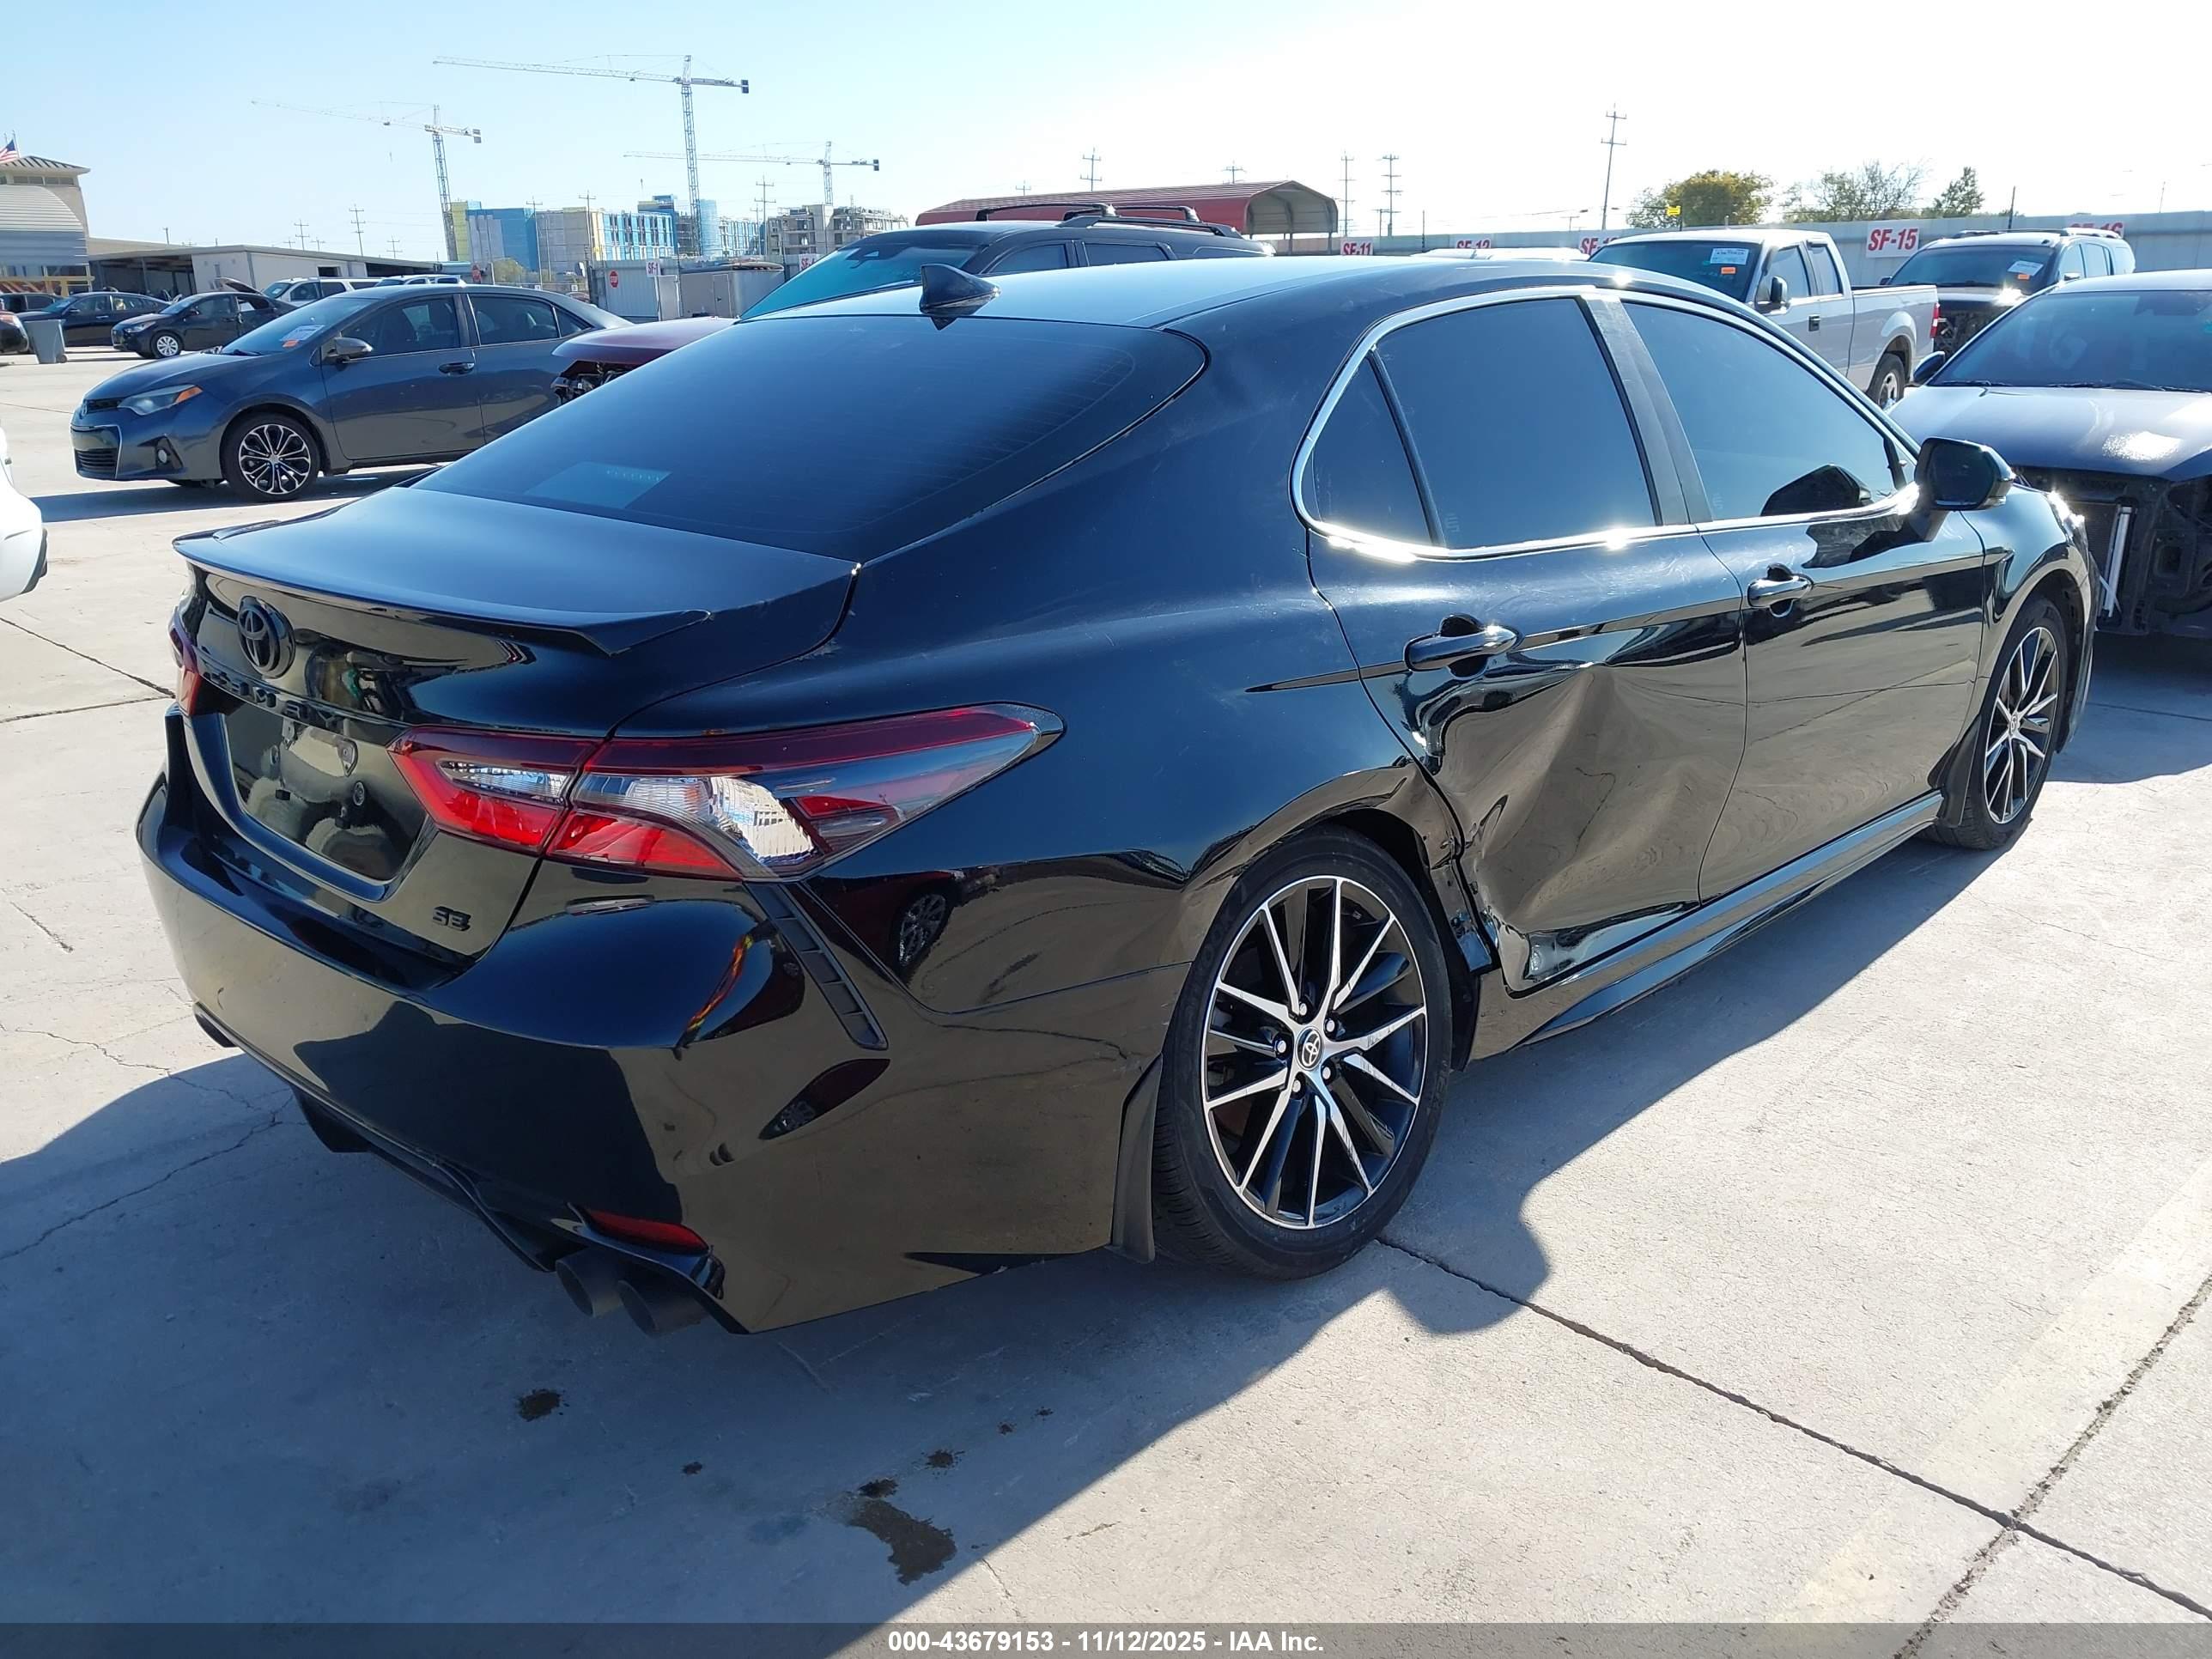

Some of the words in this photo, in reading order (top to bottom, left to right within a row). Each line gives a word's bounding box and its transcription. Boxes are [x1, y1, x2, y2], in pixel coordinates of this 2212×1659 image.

[1343, 242, 1371, 255] SF-11
[1580, 237, 1618, 255] SF-
[1869, 228, 1918, 251] SF-15
[432, 906, 471, 932] SE
